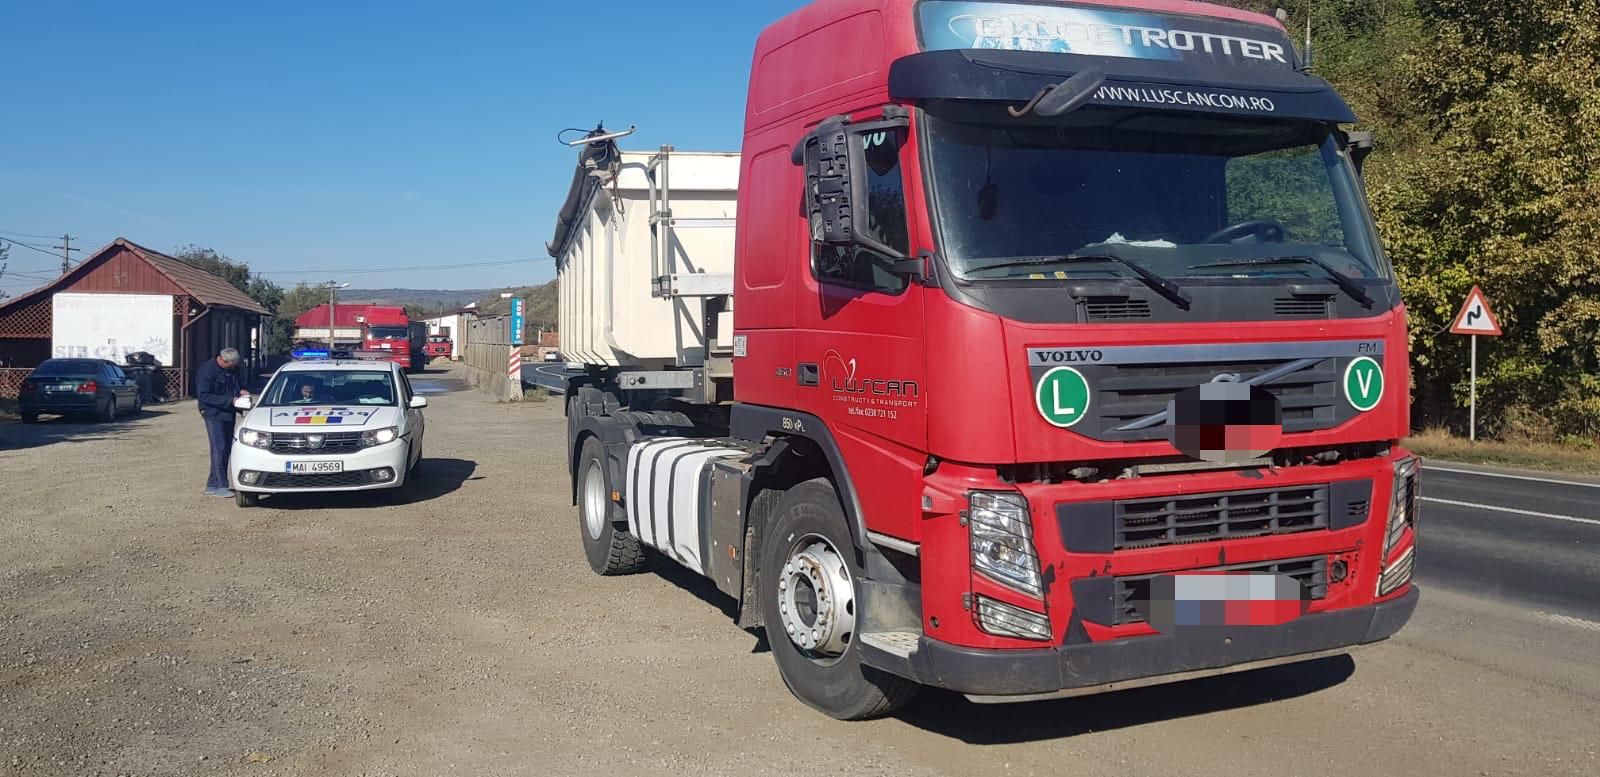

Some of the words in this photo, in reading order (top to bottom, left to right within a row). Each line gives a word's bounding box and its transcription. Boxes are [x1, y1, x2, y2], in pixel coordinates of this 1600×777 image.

[1358, 342, 1377, 352] FM
[1035, 350, 1103, 362] VOLVO
[832, 377, 919, 398] LUSCAN
[1356, 368, 1373, 398] V
[1052, 379, 1075, 415] L
[292, 463, 307, 472] MAI
[311, 462, 340, 472] 49569
